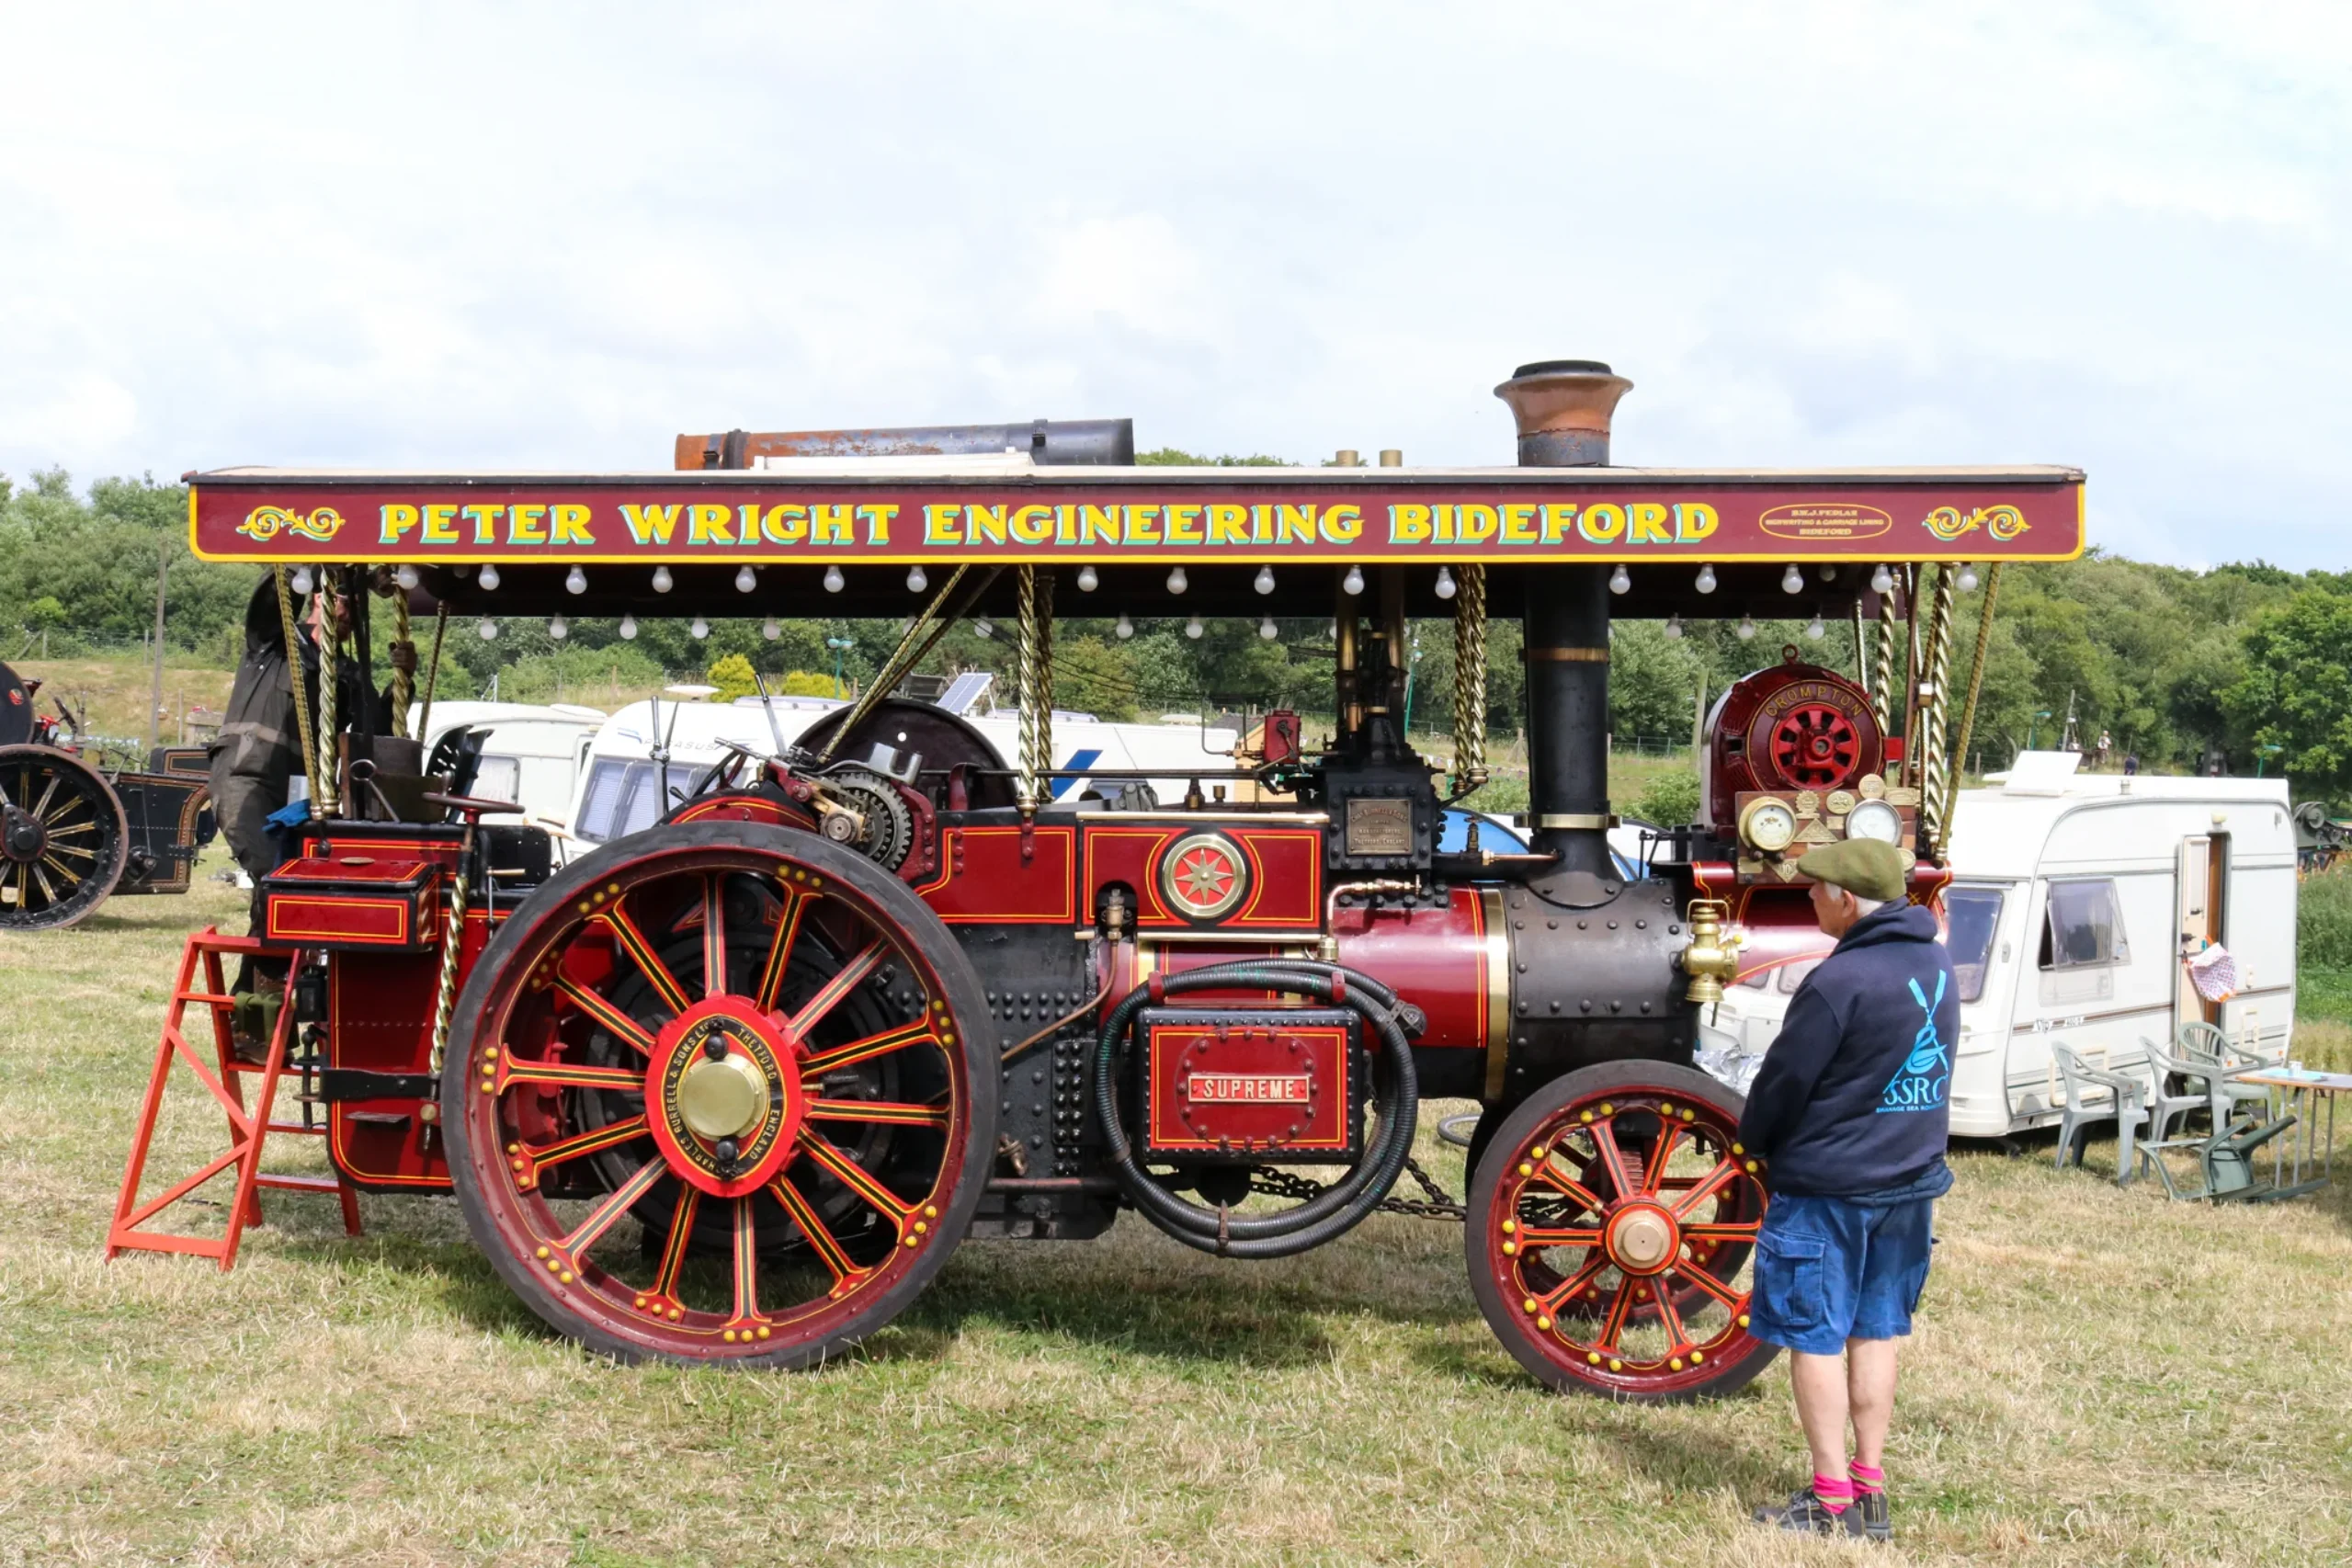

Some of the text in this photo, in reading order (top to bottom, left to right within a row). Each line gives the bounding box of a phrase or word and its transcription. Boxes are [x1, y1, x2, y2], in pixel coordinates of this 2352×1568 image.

[378, 503, 1720, 546] PETER WRIGHT ENGINEERING BIDEFORD
[1766, 685, 1864, 717] CROMPTON
[644, 738, 715, 750] PASUS
[673, 1038, 697, 1067] SONS
[737, 1028, 778, 1080] THETFORD
[669, 1069, 678, 1078] &
[1202, 1079, 1295, 1099] SUPREME
[1883, 1075, 1949, 1106] SSRC
[666, 1083, 683, 1134] BURRELL
[1905, 1104, 1920, 1112] SEA
[749, 1109, 780, 1160] ENGLAND
[680, 1137, 715, 1171] HARLES
